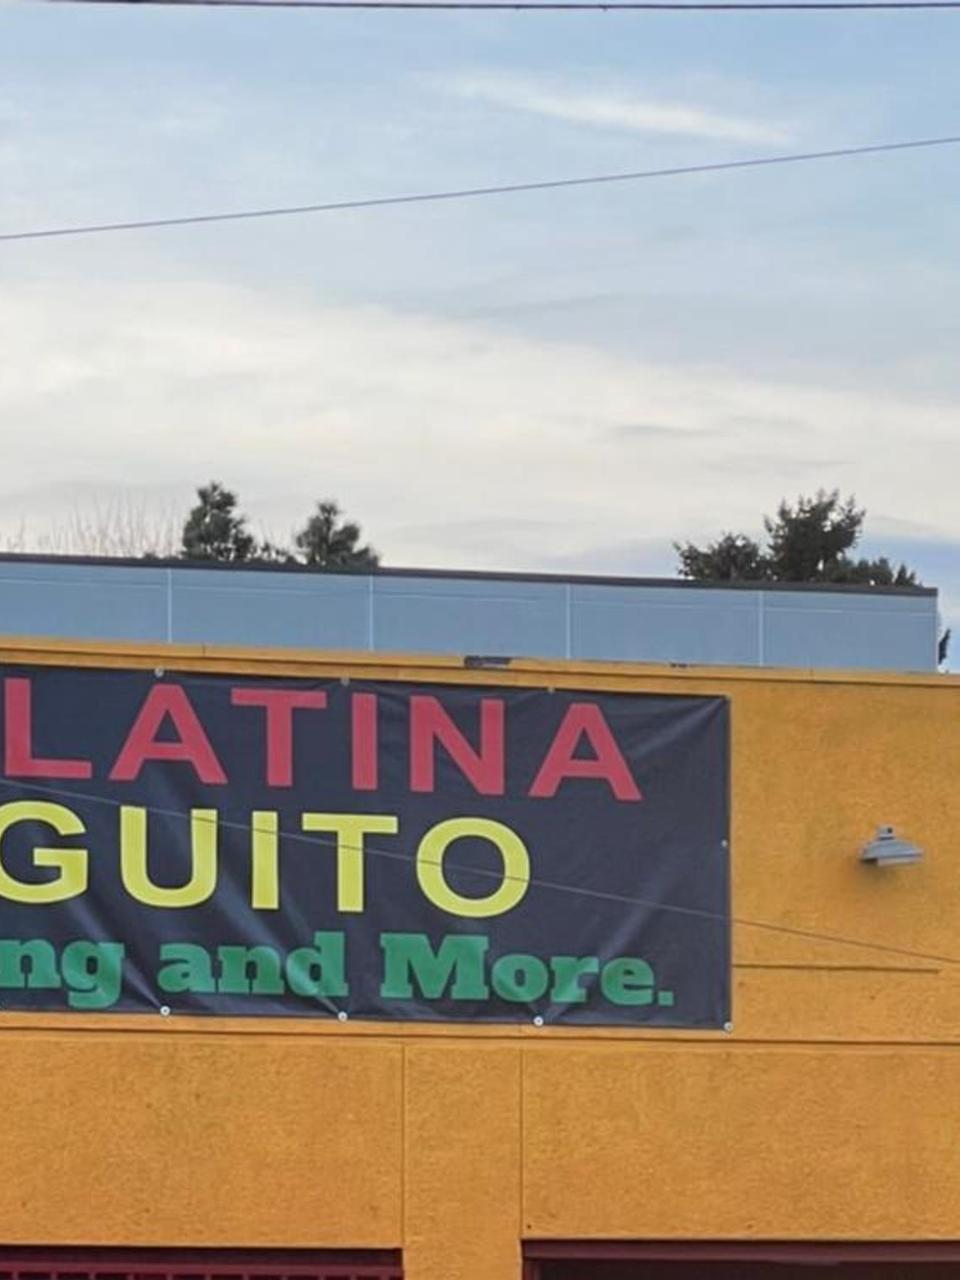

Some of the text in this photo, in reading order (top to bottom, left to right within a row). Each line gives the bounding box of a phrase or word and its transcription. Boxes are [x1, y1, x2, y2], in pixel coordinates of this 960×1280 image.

[3, 677, 642, 802] LATINA
[157, 930, 348, 999] and
[380, 932, 675, 1007] More.
